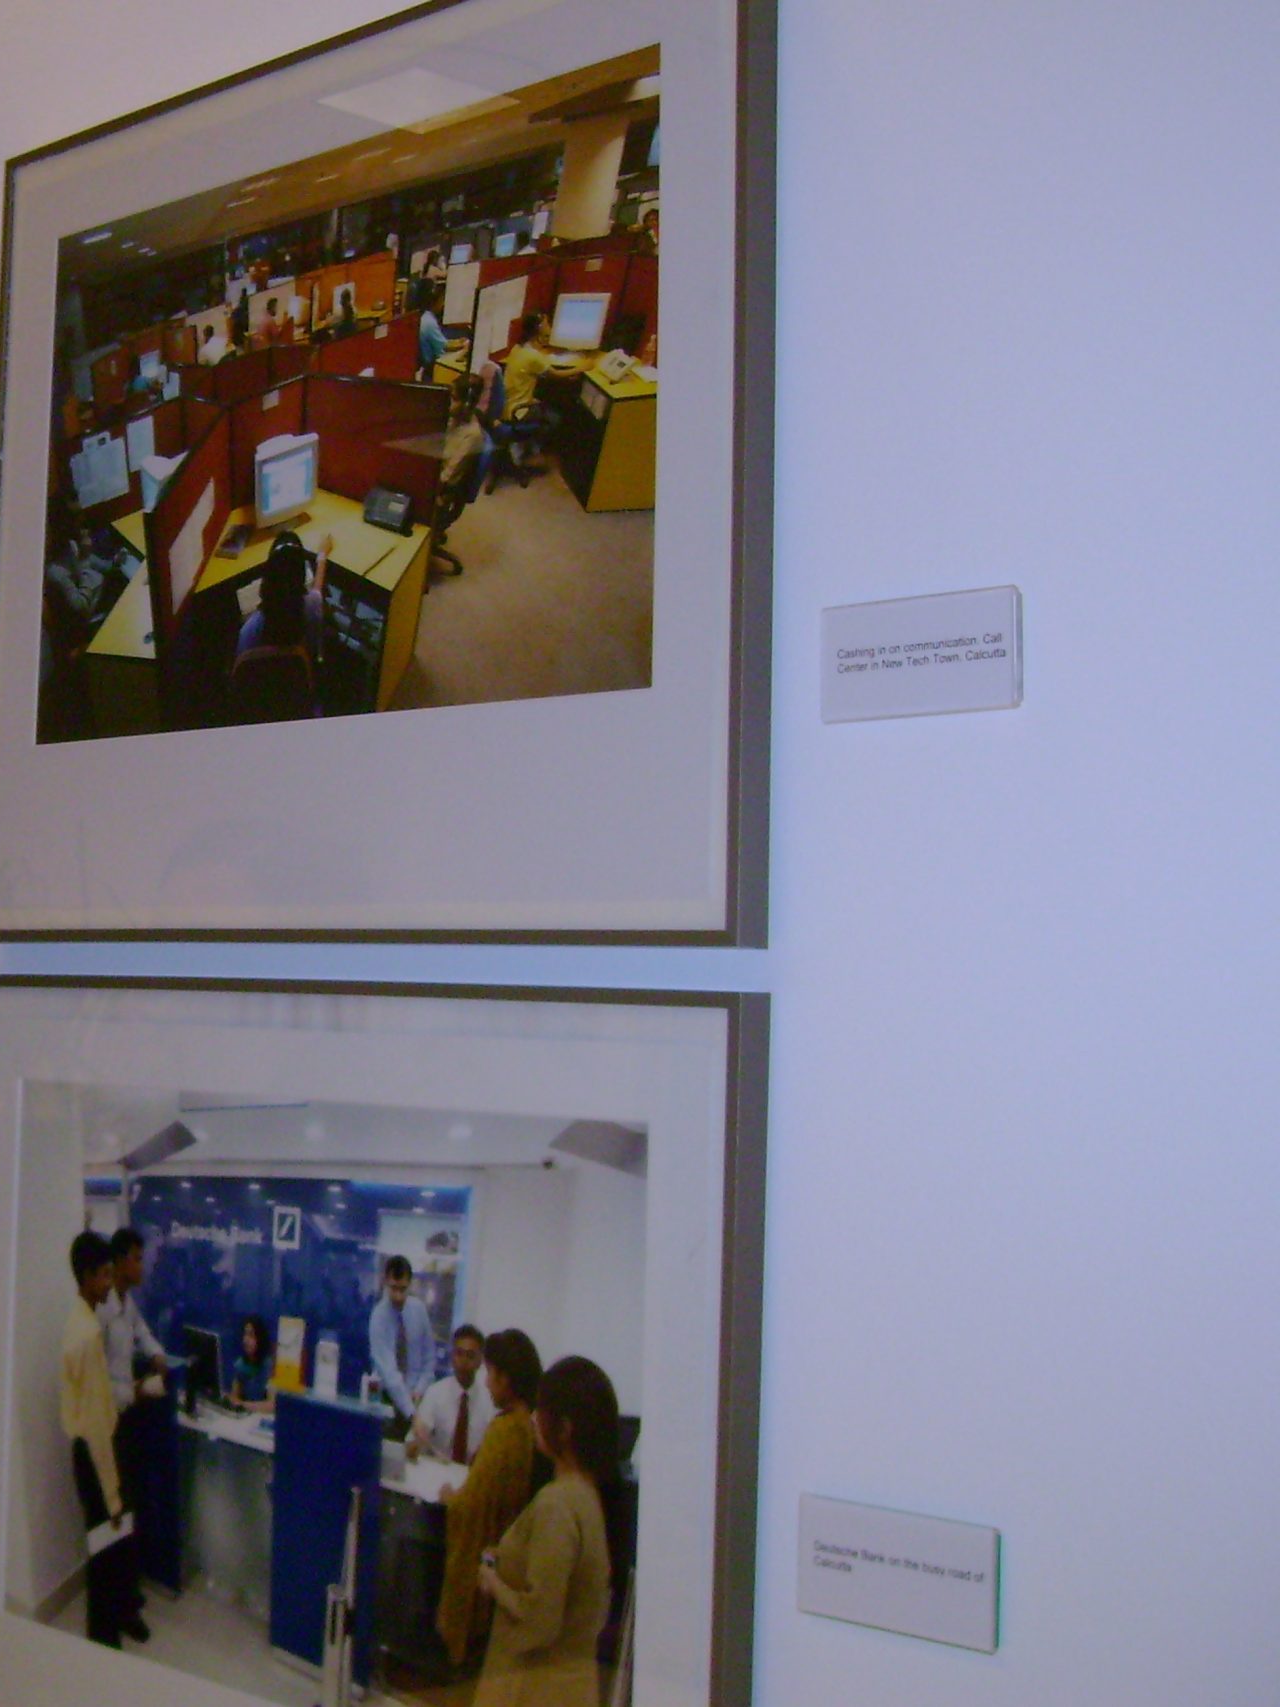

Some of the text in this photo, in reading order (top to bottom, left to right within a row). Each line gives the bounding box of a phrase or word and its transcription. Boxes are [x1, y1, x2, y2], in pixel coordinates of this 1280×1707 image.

[837, 647, 875, 660] Cashing
[878, 646, 886, 655] in
[888, 645, 901, 654] on
[982, 633, 1003, 644] Call
[837, 662, 868, 674] Center
[870, 661, 879, 671] in
[881, 658, 903, 669] New
[906, 655, 930, 666] Tech
[965, 647, 1007, 661] Calcutta
[814, 1540, 985, 1583] Deutsche Bank on the busy road of
